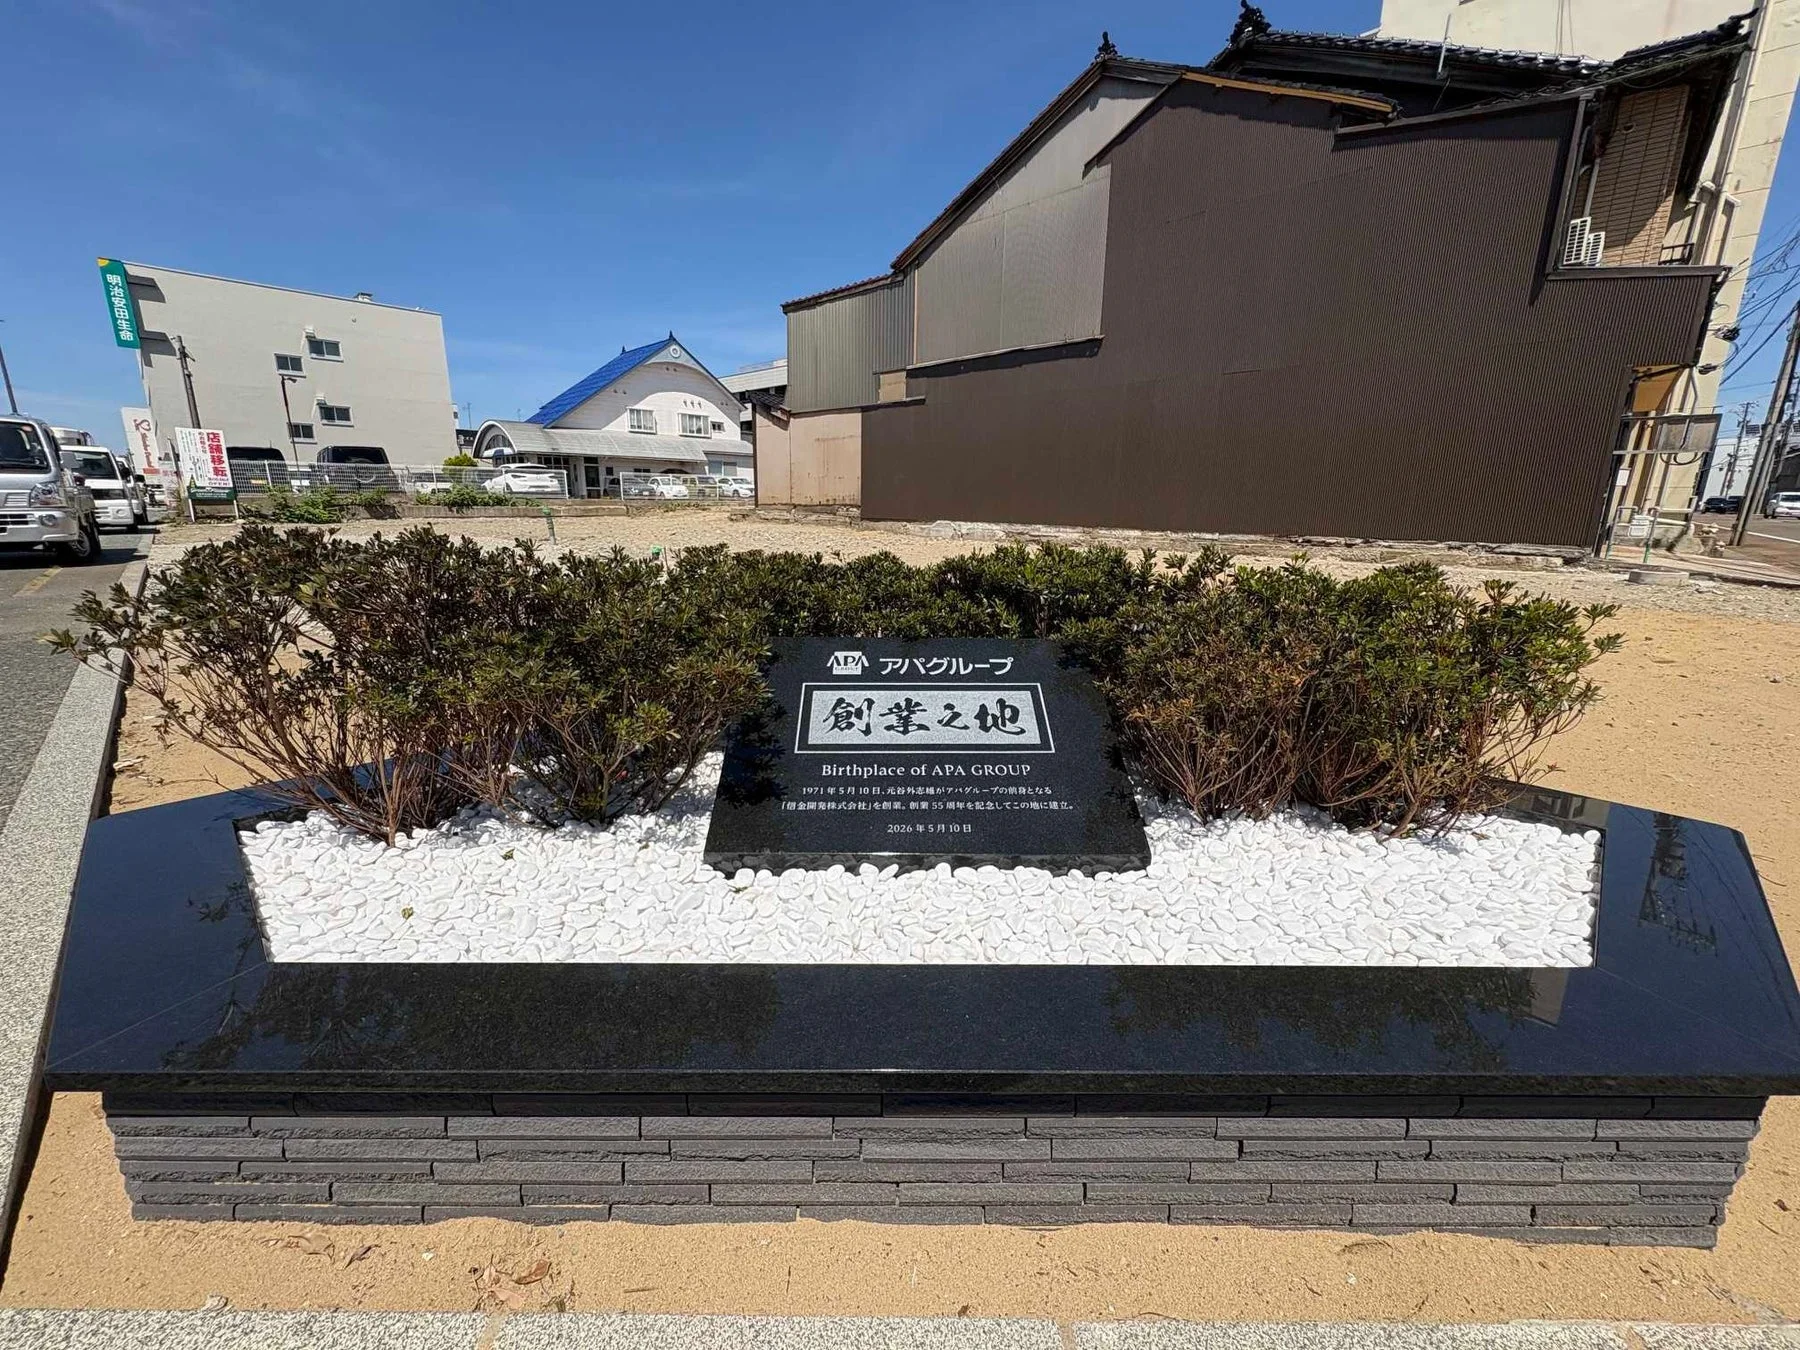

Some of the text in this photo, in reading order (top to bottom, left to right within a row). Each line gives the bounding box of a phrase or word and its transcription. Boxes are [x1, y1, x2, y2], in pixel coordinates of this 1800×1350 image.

[106, 274, 134, 341] 明治安田生命
[206, 432, 228, 477] 店舗移転
[826, 651, 870, 667] APA
[879, 657, 1014, 675] アパグループ
[823, 697, 1026, 737] 創業之地
[822, 764, 1030, 778] Birthplace of APA GROUP
